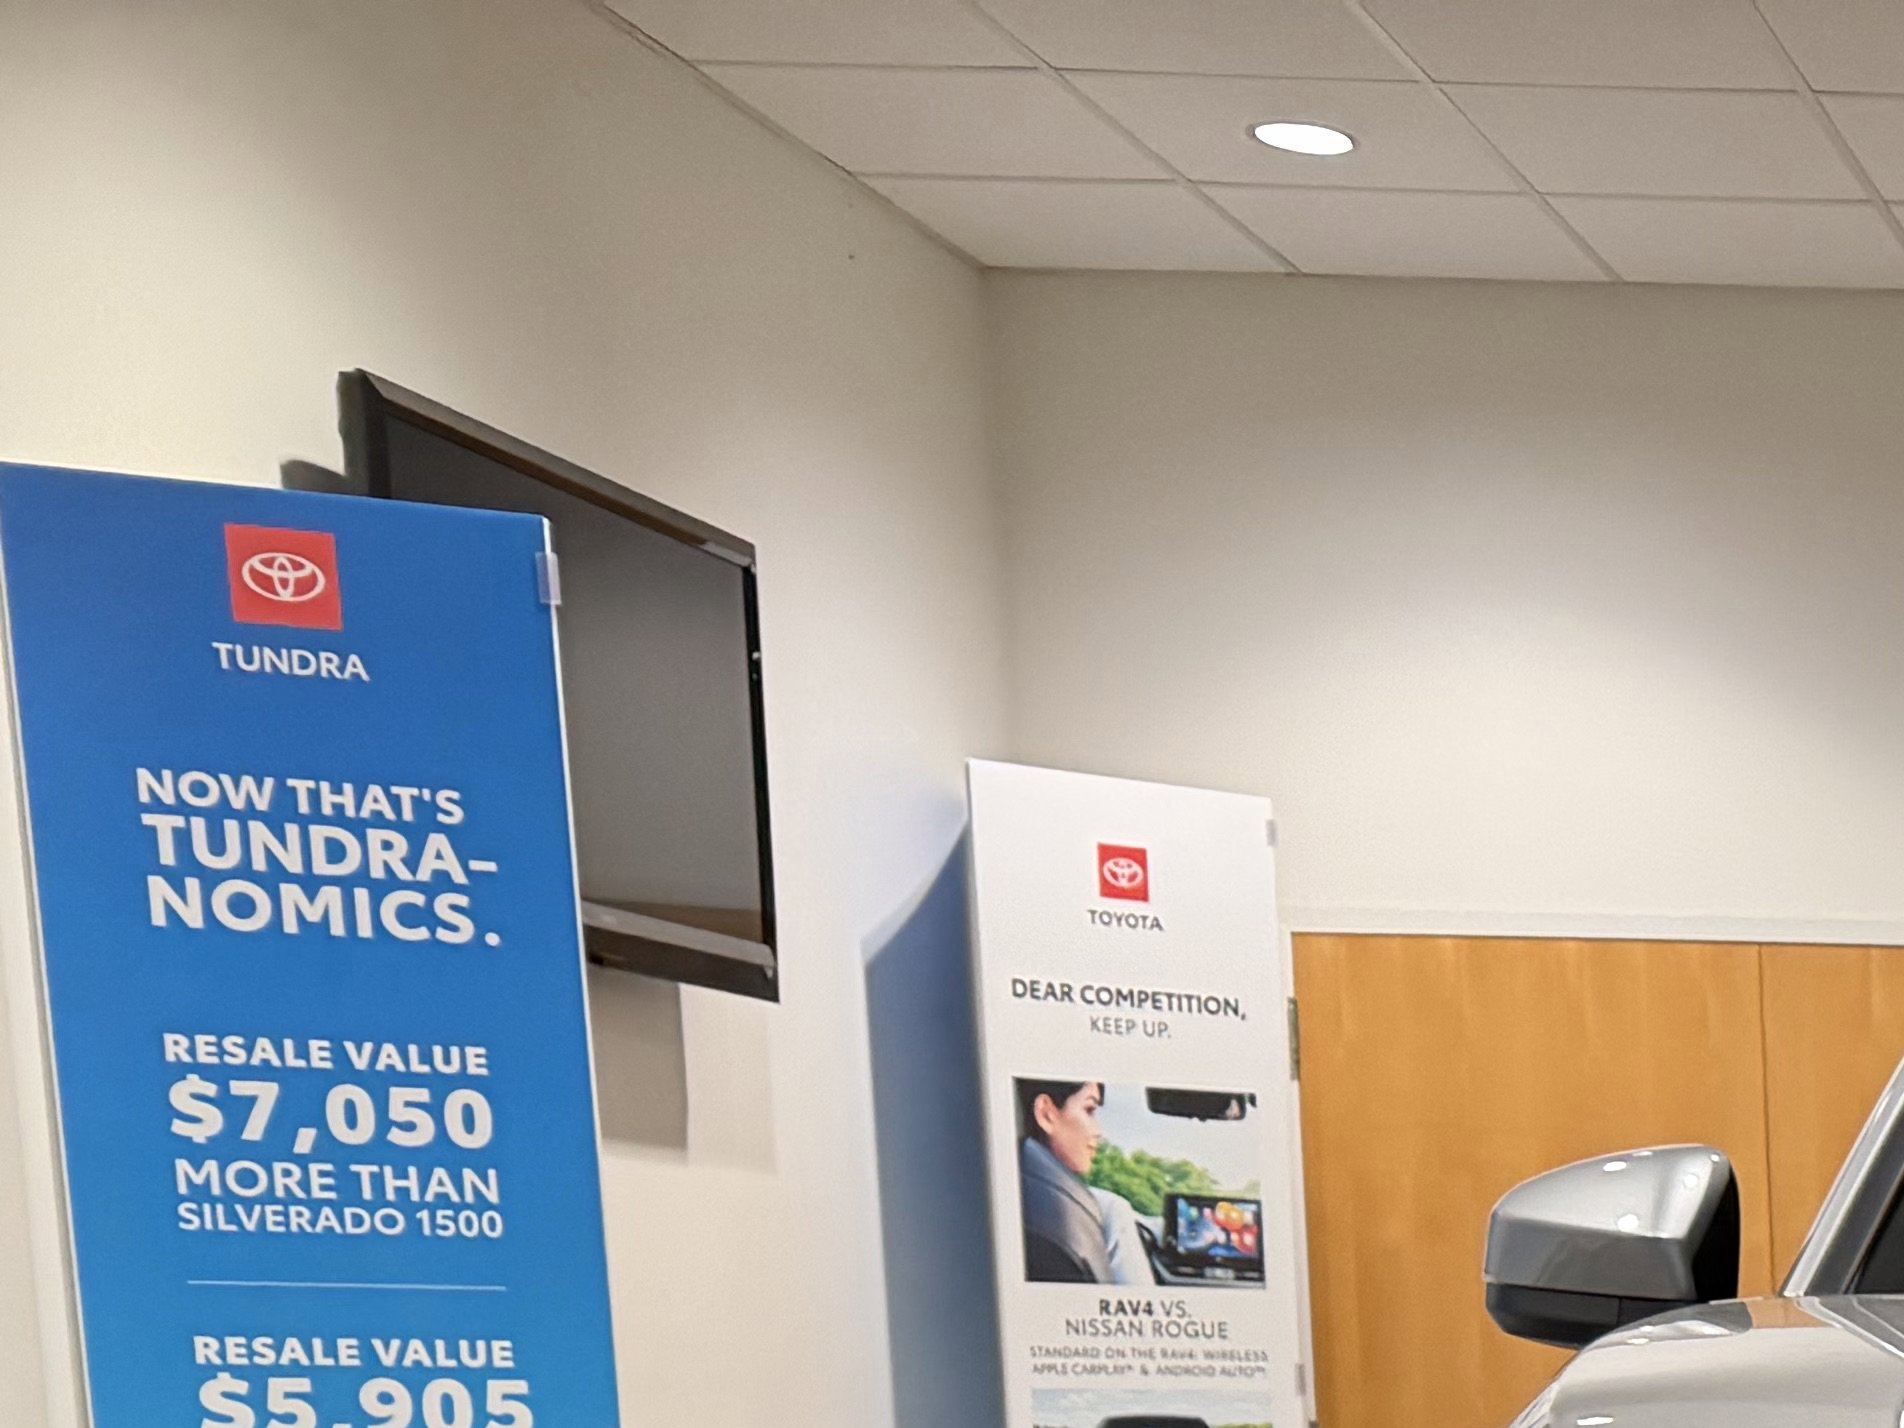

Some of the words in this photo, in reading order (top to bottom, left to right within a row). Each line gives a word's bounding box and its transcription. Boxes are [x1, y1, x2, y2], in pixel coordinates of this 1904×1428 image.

[212, 641, 371, 683] TUNDRA
[136, 768, 273, 812] NOW
[287, 780, 465, 825] THAT'S
[141, 814, 499, 885] TUNDRA-
[146, 875, 502, 948] NOMICS.
[1087, 909, 1164, 932] TOYOTA
[1011, 977, 1074, 1004] DEAR
[1080, 985, 1247, 1021] COMPETITION,
[1089, 1015, 1136, 1037] KEEP
[1142, 1020, 1172, 1039] UP.
[162, 1033, 333, 1069] RESALE
[344, 1042, 489, 1076] VALUE
[168, 1075, 494, 1156] $7,050
[173, 1158, 338, 1198] MORE
[349, 1164, 500, 1203] THAN
[176, 1201, 406, 1236] SILVERADO
[415, 1208, 505, 1239] 1500
[1065, 1319, 1144, 1338] NISSAN
[1152, 1320, 1229, 1340] ROGUE
[1099, 1299, 1154, 1317] RAV4
[1161, 1300, 1192, 1319] VS.
[193, 1336, 361, 1367] RESALE
[371, 1339, 515, 1368] VALUE
